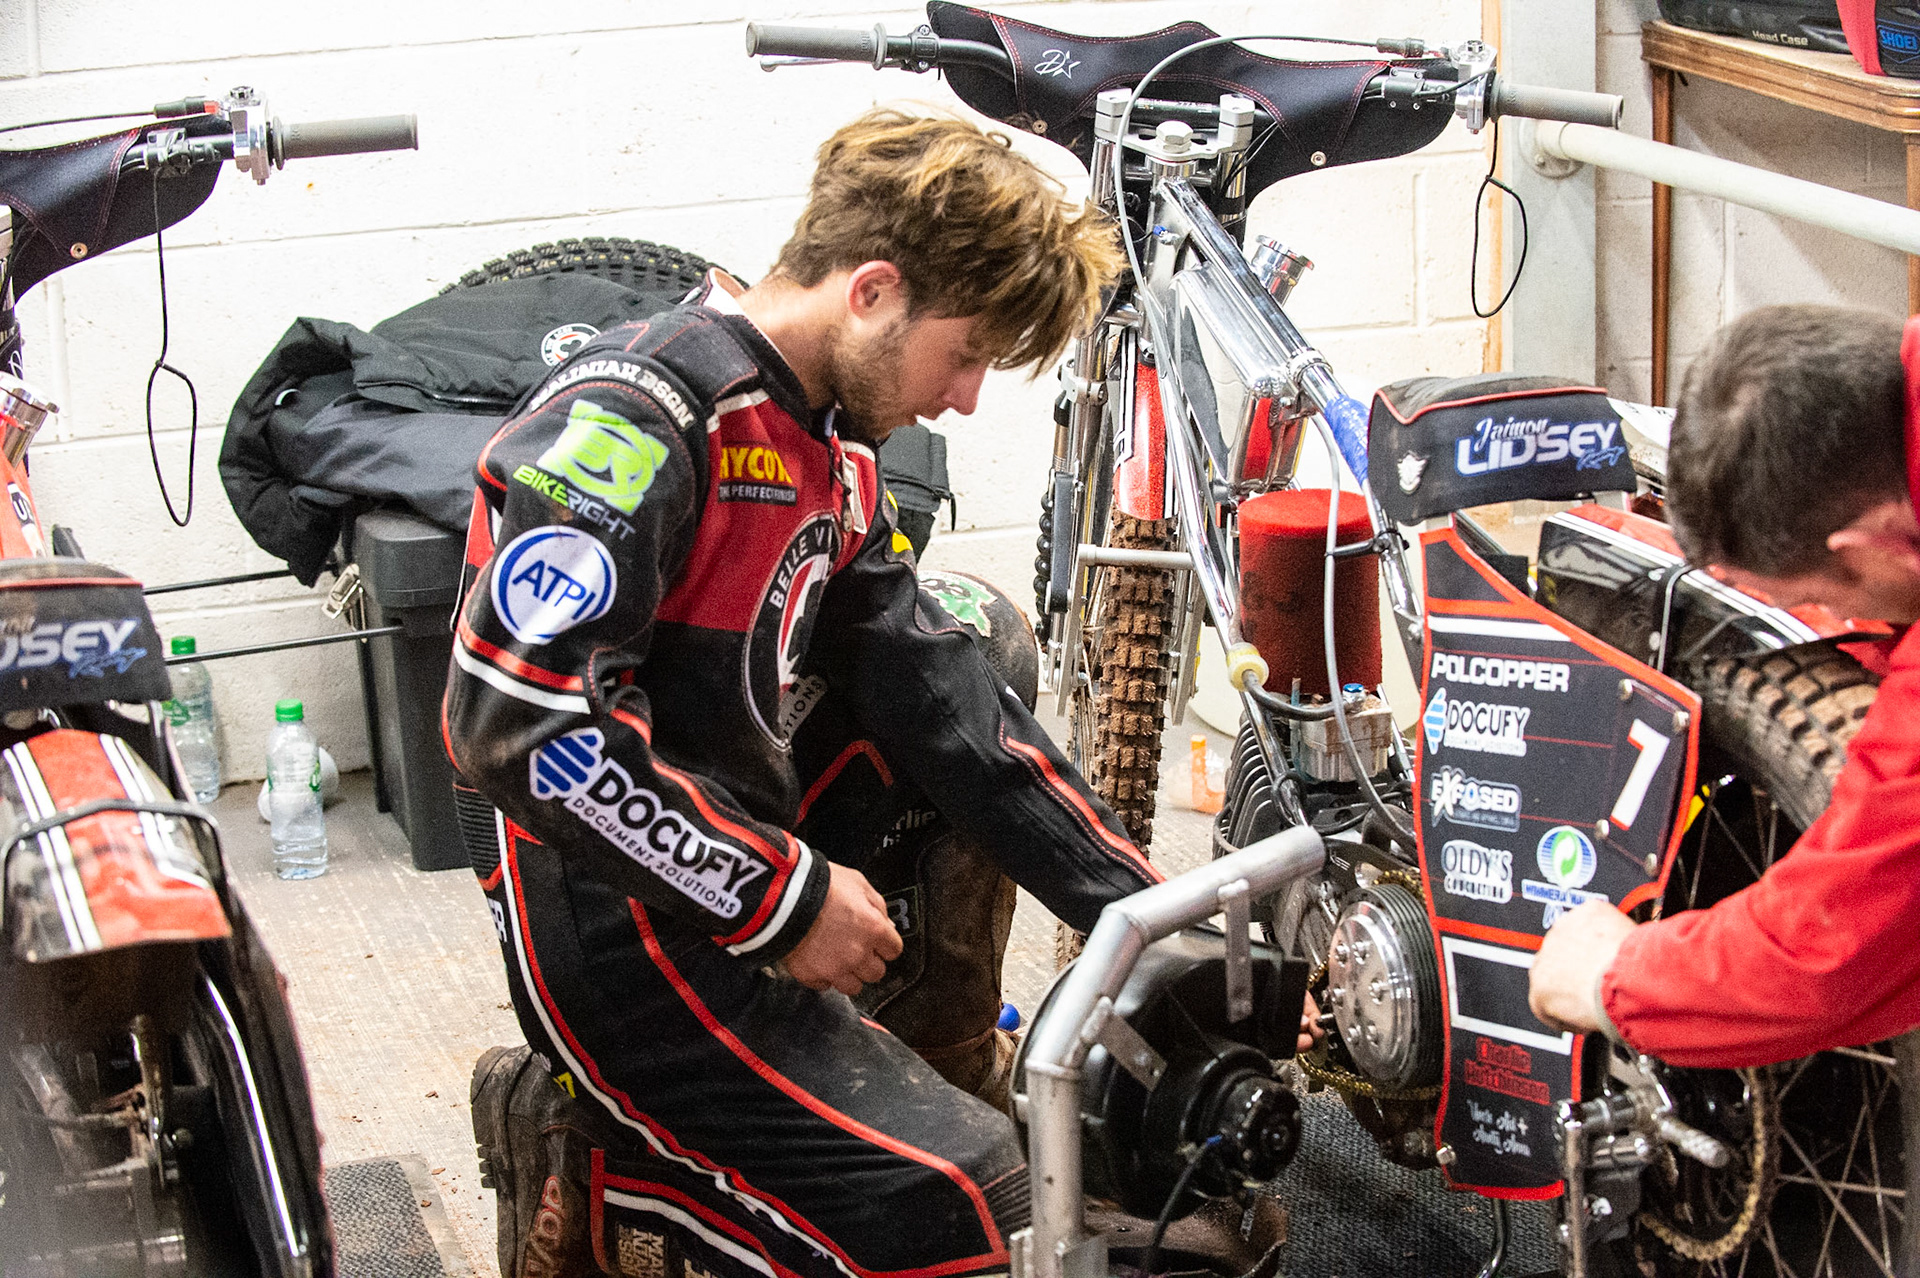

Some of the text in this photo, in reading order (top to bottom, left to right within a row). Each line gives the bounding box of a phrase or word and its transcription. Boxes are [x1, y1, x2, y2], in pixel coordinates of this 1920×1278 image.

[1753, 30, 1809, 46] Head Case
[1880, 29, 1918, 50] SHOEI
[1457, 422, 1617, 475] LIDSEY
[512, 464, 636, 541] BIKERIGHT
[511, 559, 596, 620] ATPI
[769, 534, 809, 610] BELLE
[1431, 652, 1570, 693] POLCOPPER
[1448, 703, 1527, 739] DOCUFY
[573, 797, 736, 915] DOCUMENT SOLUTIONS
[586, 767, 761, 893] DOCUFY
[1445, 845, 1510, 882] OLDY'S
